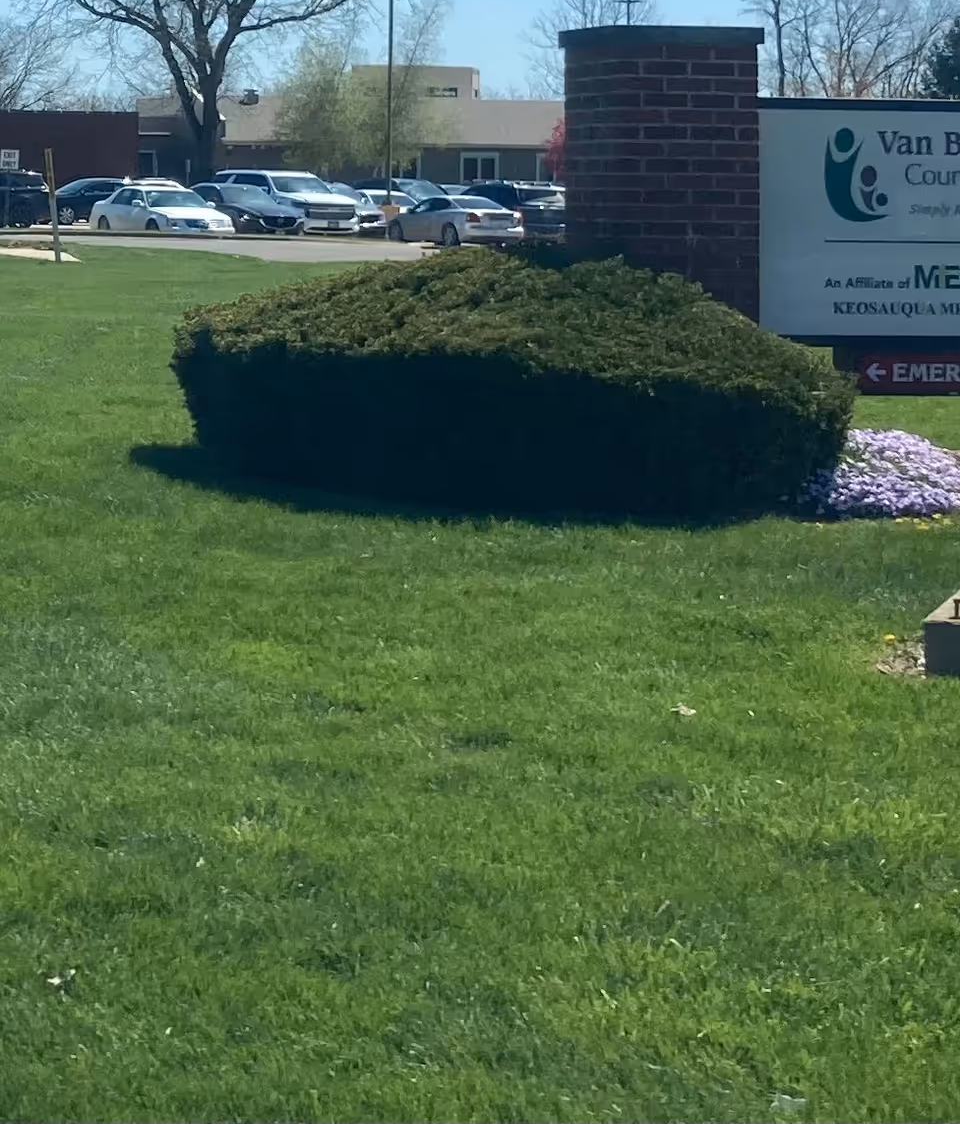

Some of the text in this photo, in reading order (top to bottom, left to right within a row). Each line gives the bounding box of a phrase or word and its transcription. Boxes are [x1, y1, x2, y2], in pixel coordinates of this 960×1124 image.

[877, 130, 932, 155] Van
[909, 203, 951, 217] Simply
[825, 277, 842, 289] An
[845, 276, 894, 289] Affiliate
[897, 276, 911, 289] of
[833, 302, 935, 318] KEOSAUQUA
